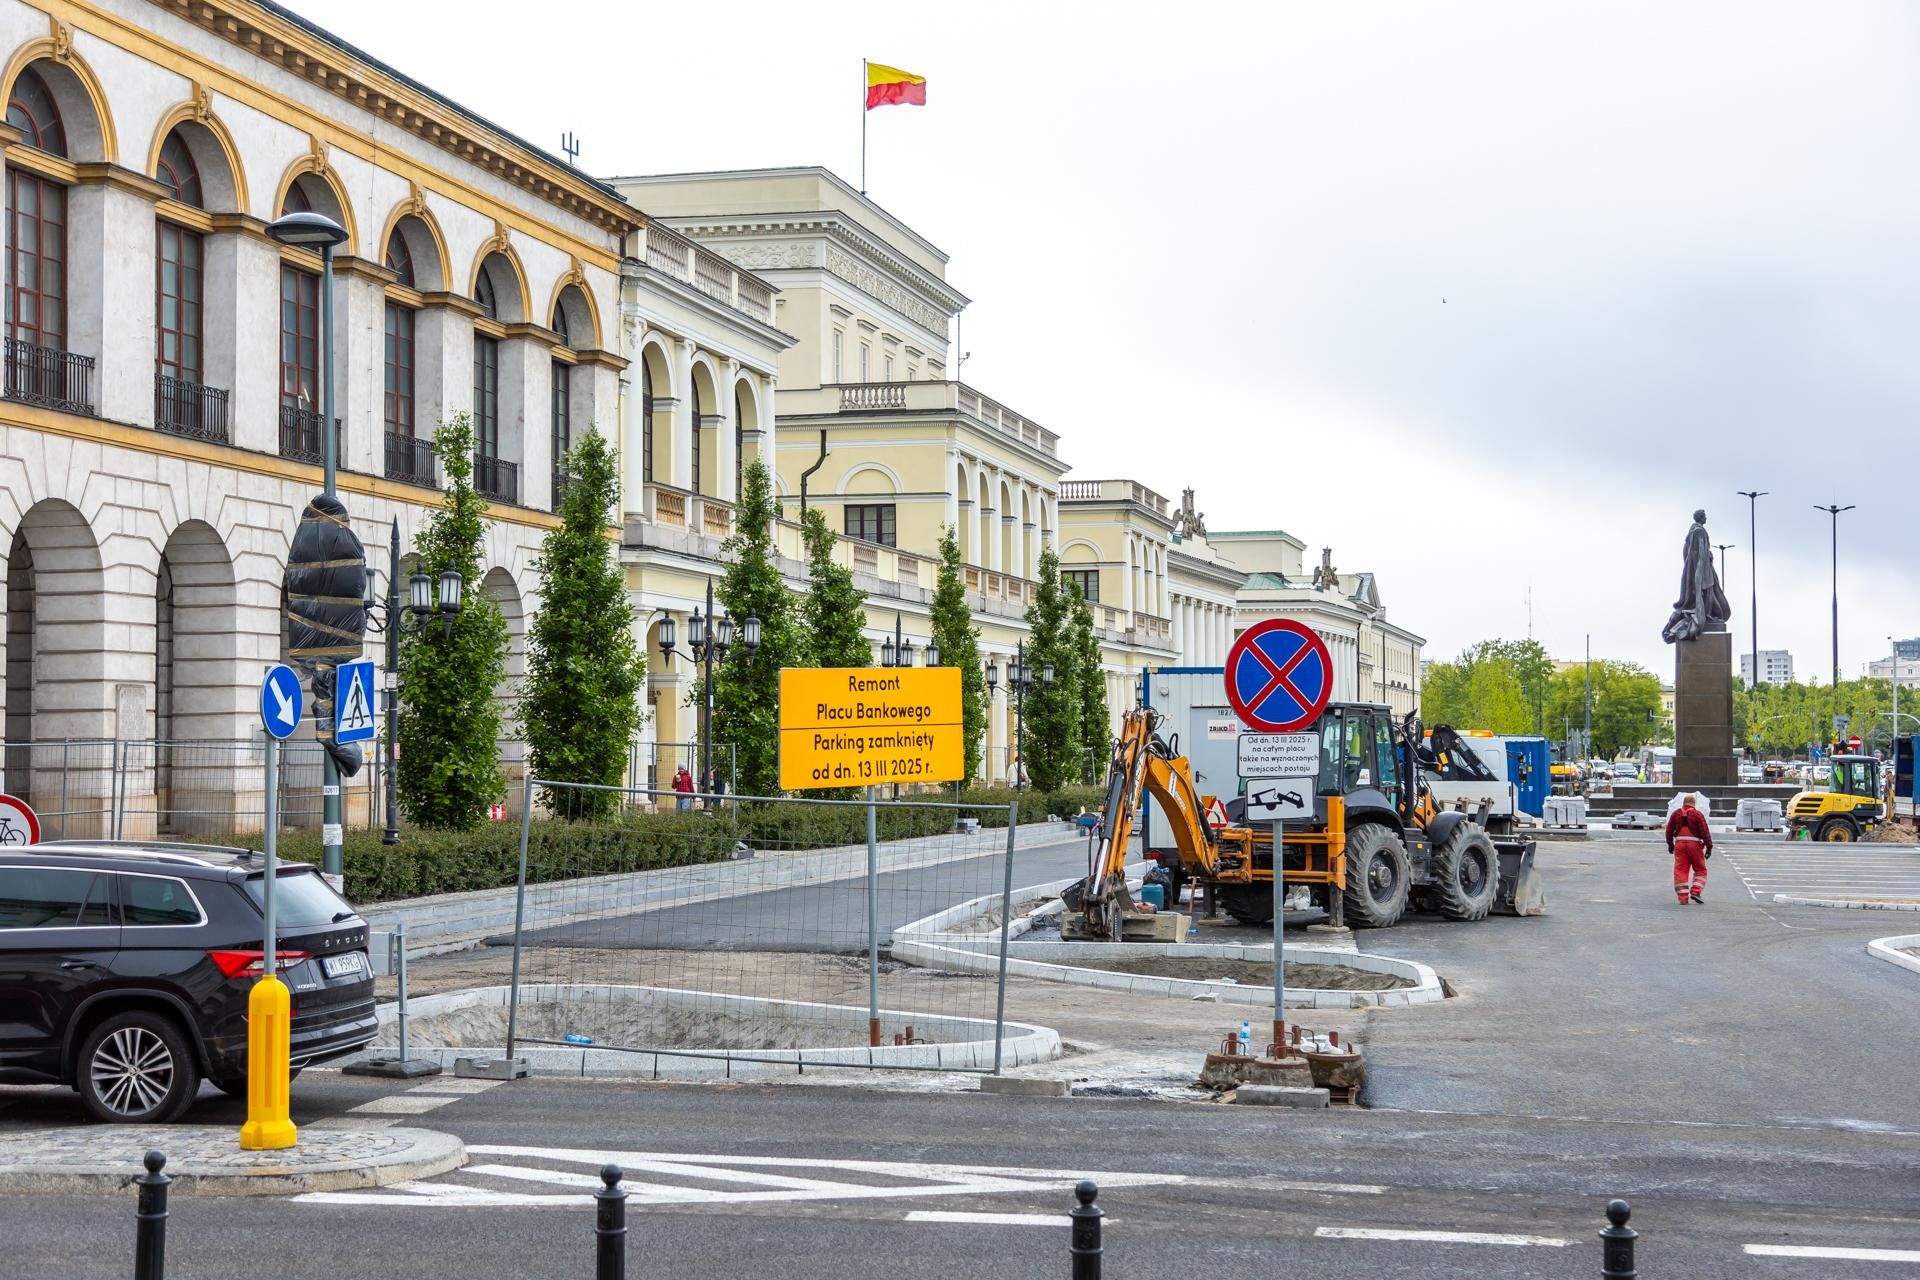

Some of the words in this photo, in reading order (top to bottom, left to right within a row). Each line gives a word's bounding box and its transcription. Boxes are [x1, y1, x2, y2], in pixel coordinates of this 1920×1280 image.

[849, 676, 900, 692] Remont
[817, 703, 853, 720] Placu
[857, 702, 931, 722] Bankowego
[814, 733, 864, 753] Parking
[868, 731, 935, 751] zamknięty
[1260, 736, 1271, 744] dn.
[1272, 736, 1280, 744] 13
[1263, 745, 1285, 753] całym
[1286, 745, 1306, 753] placu
[1271, 754, 1319, 763] wyznaczonych
[812, 763, 829, 780] od
[834, 762, 855, 780] dn.
[858, 761, 872, 778] 13
[876, 760, 887, 777] III
[891, 758, 922, 776] 2025
[925, 764, 933, 775] r.
[1246, 765, 1283, 774] miejscach
[1284, 765, 1311, 774] postoju
